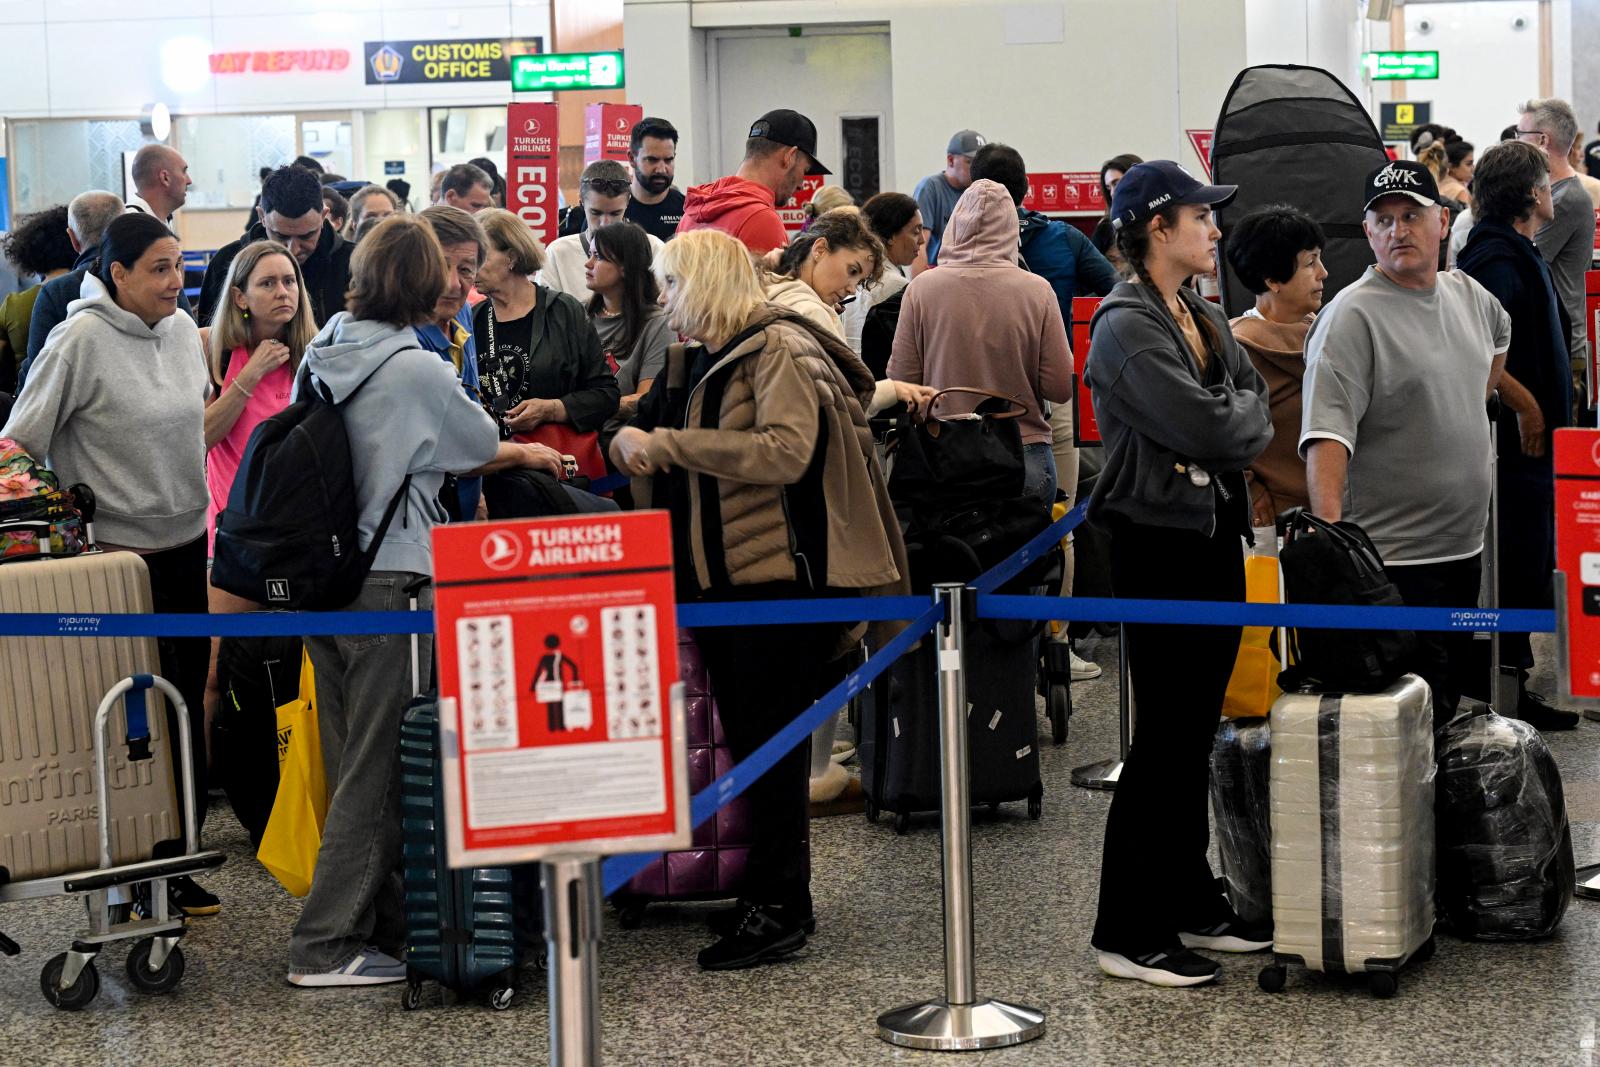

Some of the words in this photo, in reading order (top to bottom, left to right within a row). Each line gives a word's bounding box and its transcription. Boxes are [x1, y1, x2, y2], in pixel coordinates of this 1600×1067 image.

[411, 43, 502, 61] CUSTOMS
[208, 53, 250, 73] VAT
[251, 49, 350, 72] REFUND
[424, 61, 492, 78] OFFICE
[1148, 193, 1172, 210] ЯМАЛ
[527, 523, 622, 547] TURKISH
[528, 544, 624, 567] AIRLINES
[58, 617, 101, 626] injourney
[1451, 612, 1500, 621] injourney
